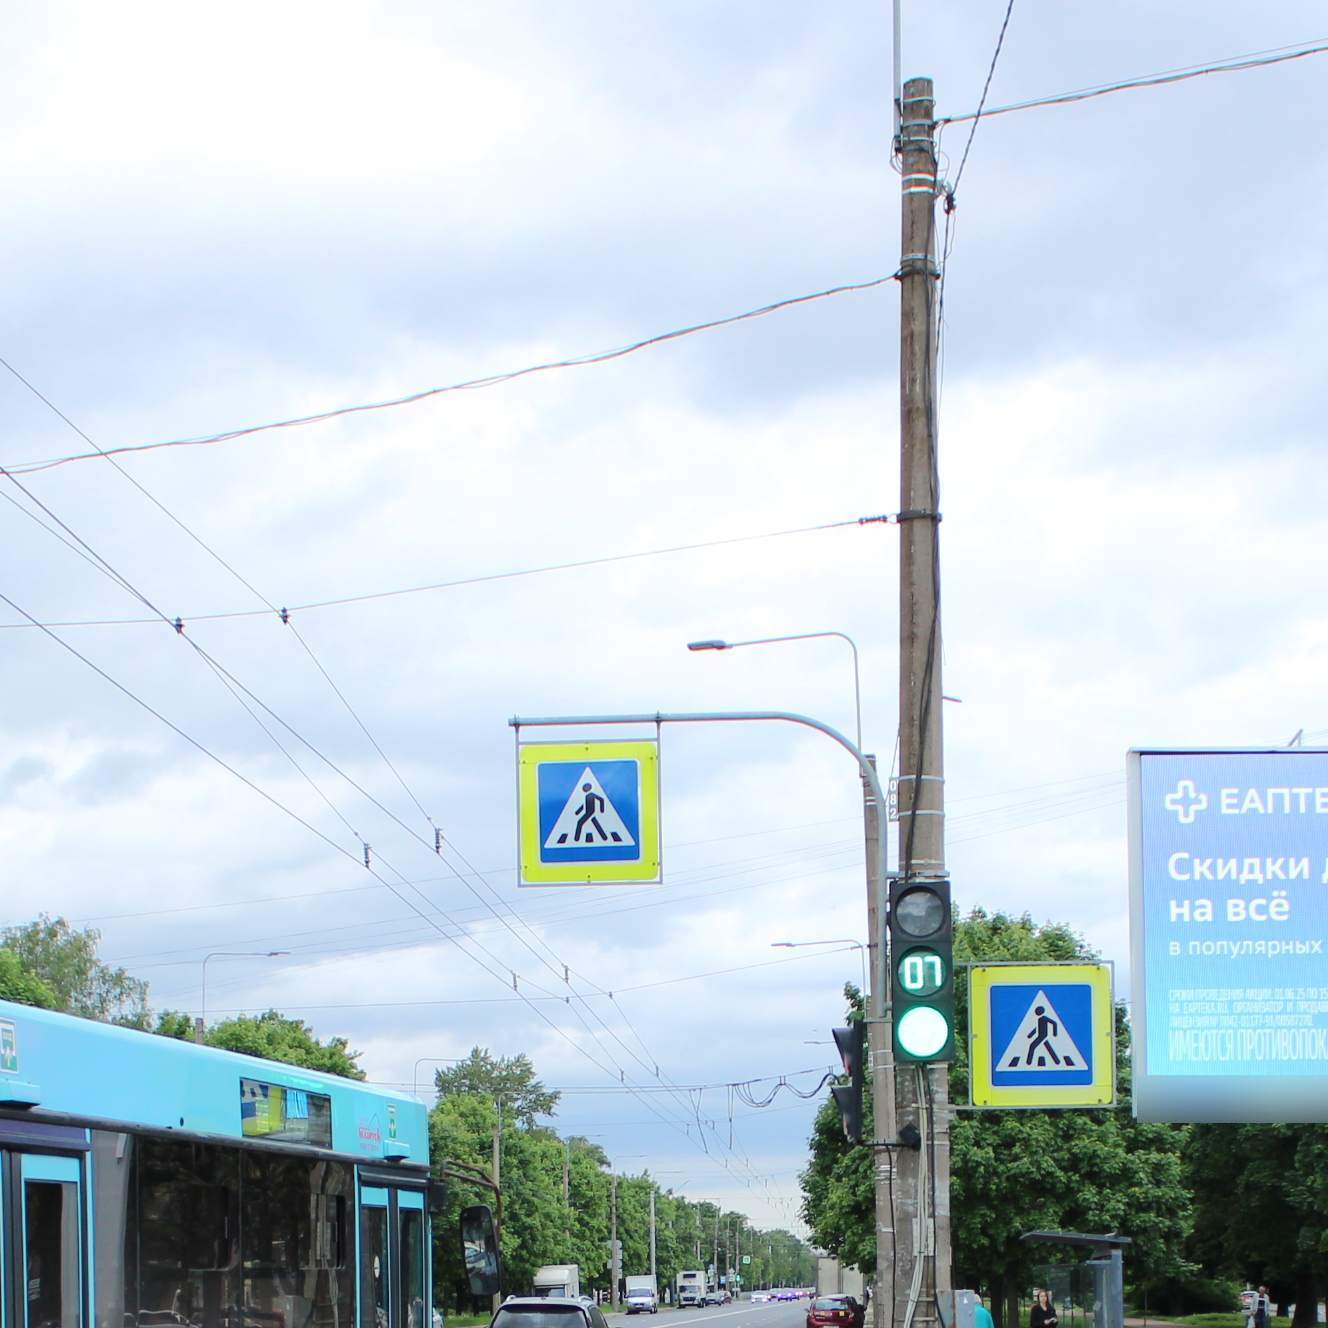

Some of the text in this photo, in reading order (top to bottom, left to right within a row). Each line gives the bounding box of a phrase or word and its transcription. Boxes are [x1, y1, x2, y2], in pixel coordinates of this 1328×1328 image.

[1167, 852, 1310, 884] Скидки
[1169, 890, 1290, 922] на всё
[1169, 942, 1180, 956] в
[1189, 938, 1322, 960] популярных
[904, 956, 942, 989] 07
[1169, 1028, 1233, 1061] ИМЕЮТСЯ
